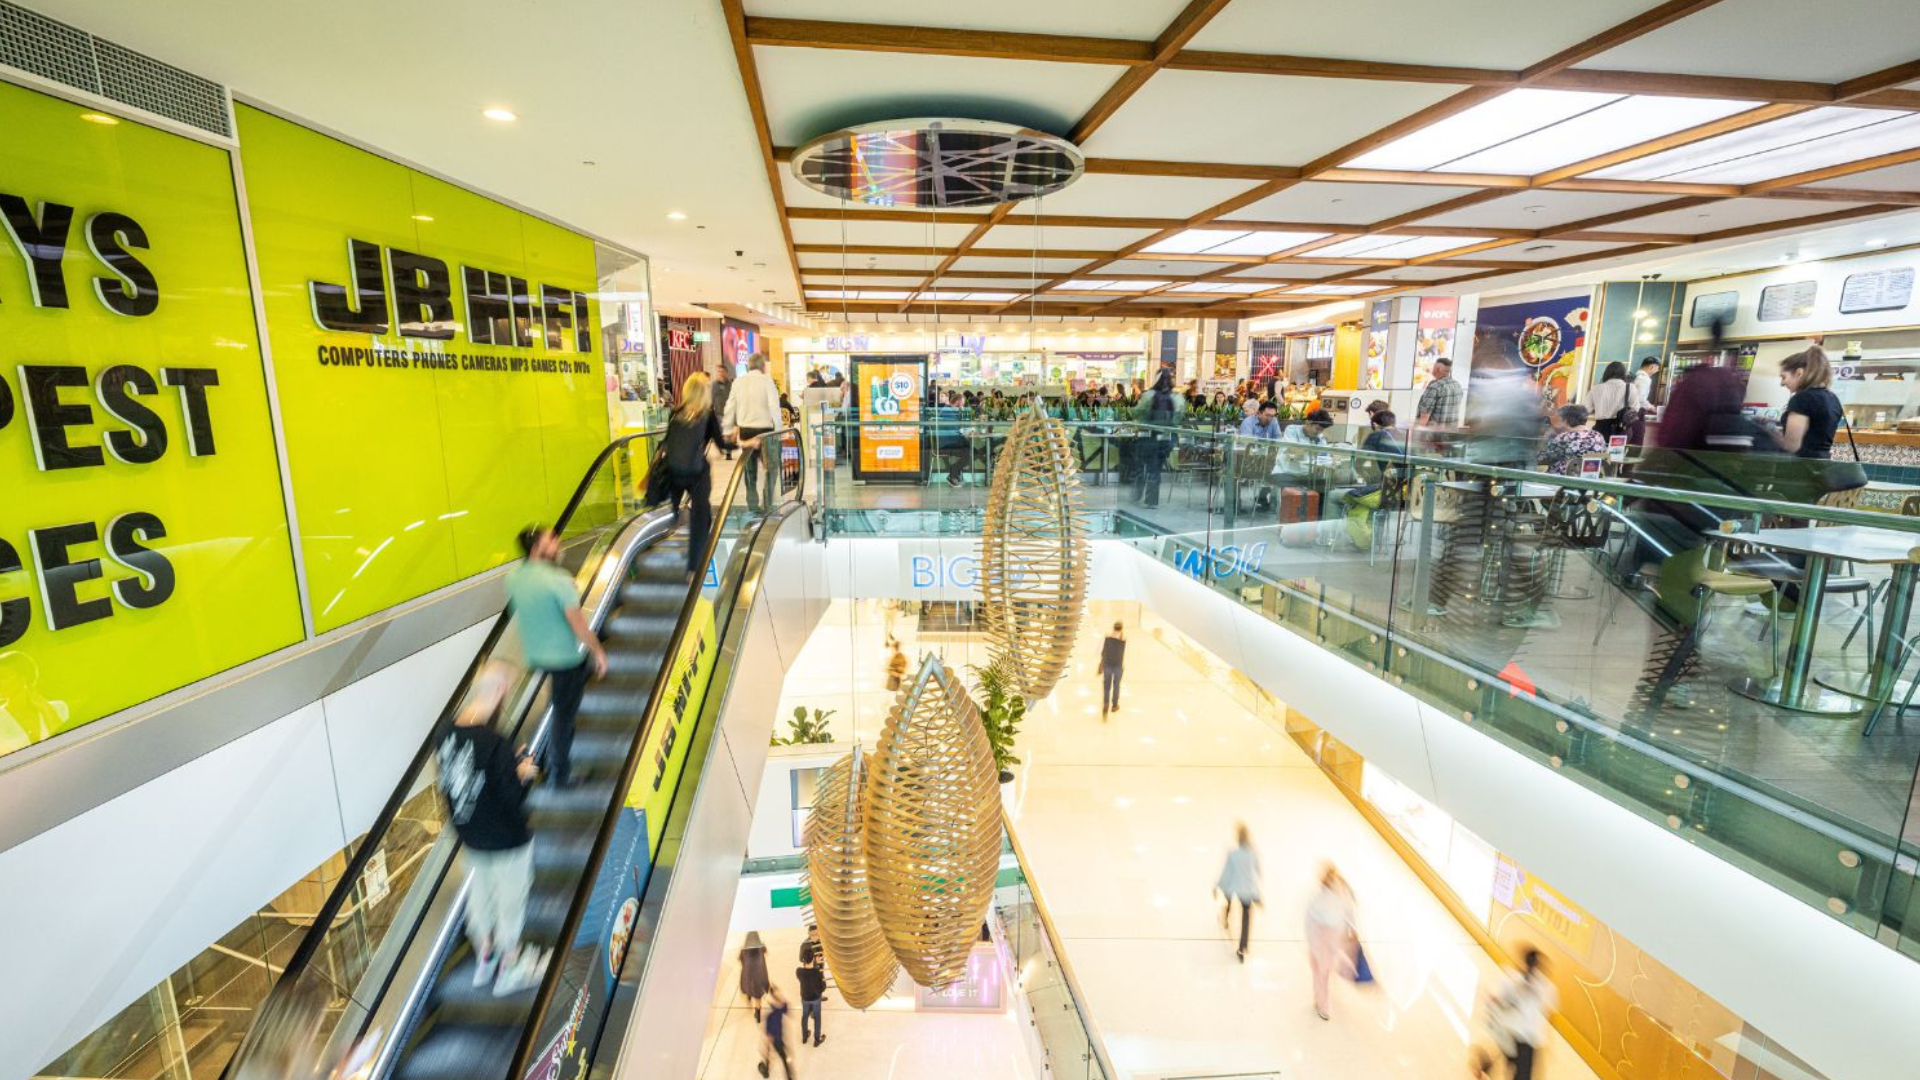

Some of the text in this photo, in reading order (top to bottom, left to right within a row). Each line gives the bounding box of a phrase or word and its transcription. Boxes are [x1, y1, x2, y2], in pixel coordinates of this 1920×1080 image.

[308, 238, 455, 341] JB
[671, 328, 690, 350] KFC
[317, 345, 408, 368] COMPUTERS
[412, 350, 458, 370] PHONES
[461, 354, 507, 372] CAMERAS
[510, 356, 529, 372] MP3
[531, 359, 557, 374] GAMES
[894, 380, 909, 390] $10
[912, 556, 979, 588] BIG
[653, 717, 677, 792] JB
